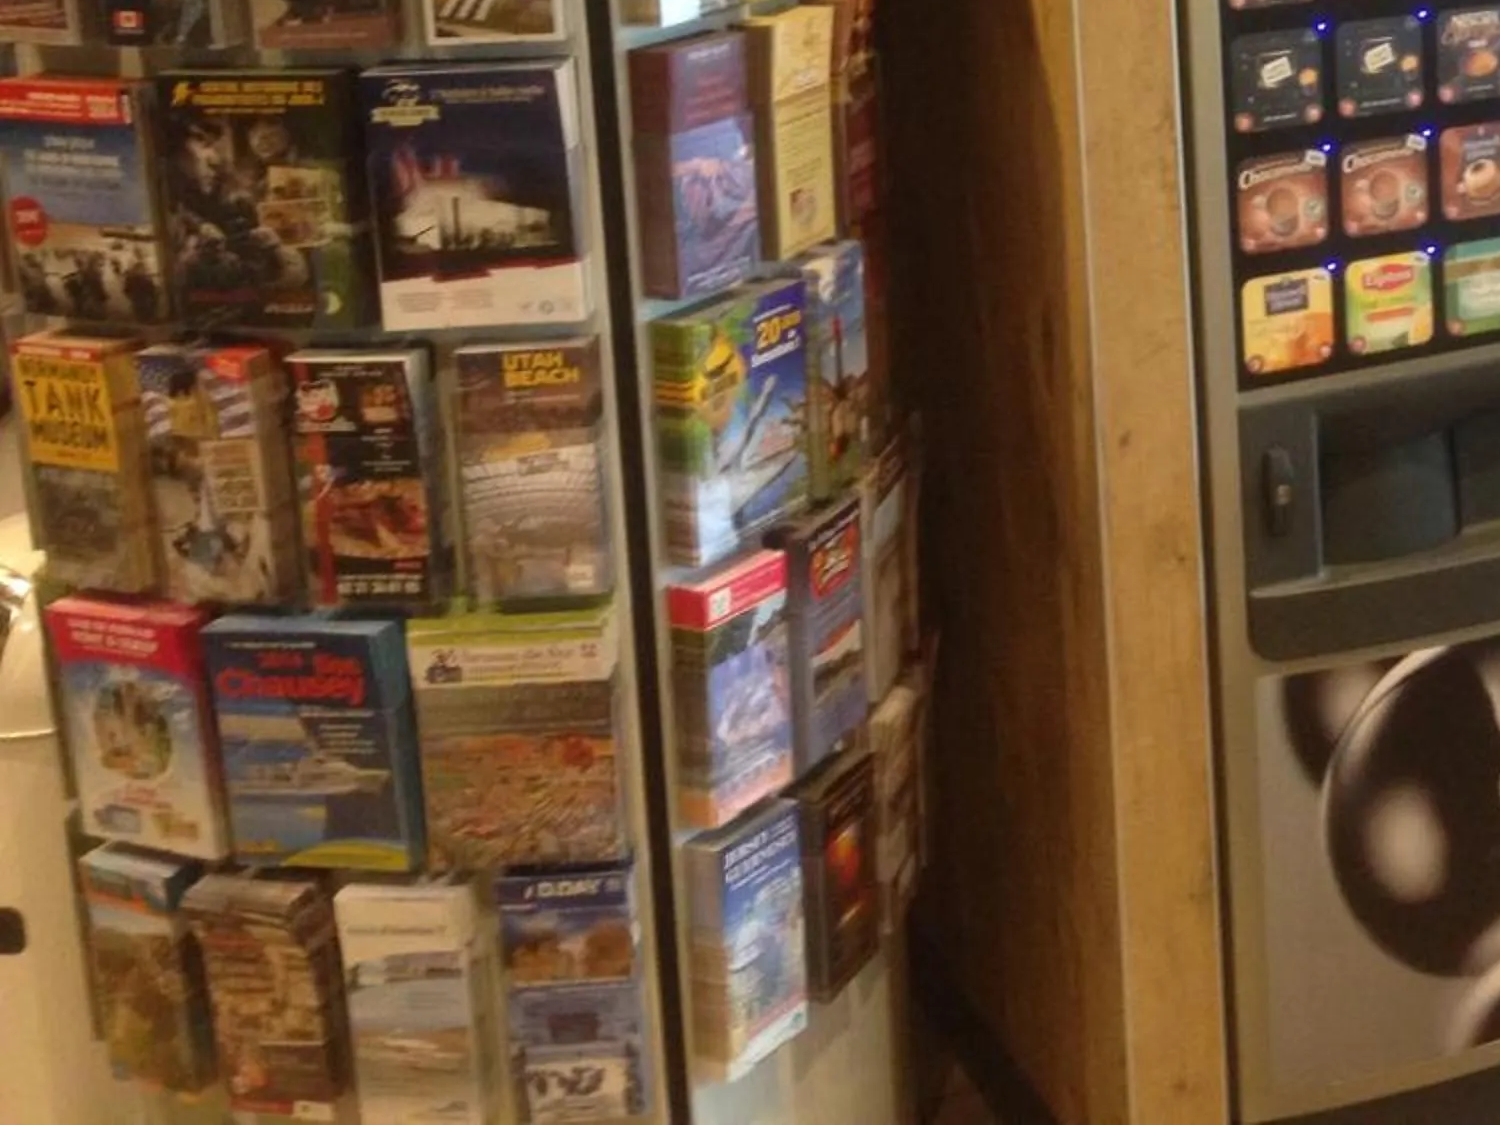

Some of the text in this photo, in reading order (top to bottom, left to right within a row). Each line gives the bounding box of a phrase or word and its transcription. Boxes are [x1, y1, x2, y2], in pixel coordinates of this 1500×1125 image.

[504, 351, 565, 371] UTAH
[505, 367, 580, 388] BEACH
[24, 379, 106, 422] TANK
[31, 421, 109, 450] MUSEUM
